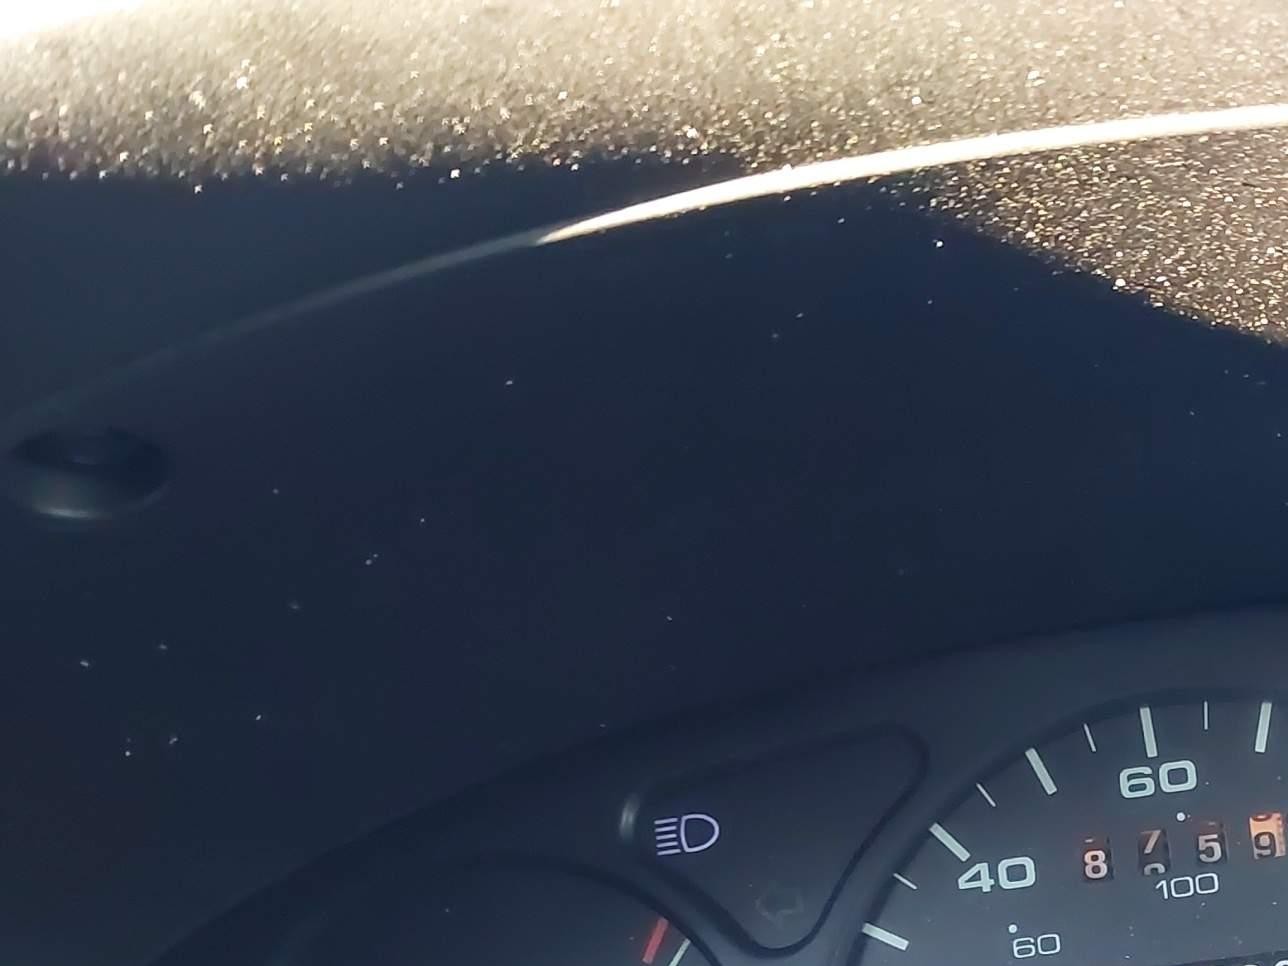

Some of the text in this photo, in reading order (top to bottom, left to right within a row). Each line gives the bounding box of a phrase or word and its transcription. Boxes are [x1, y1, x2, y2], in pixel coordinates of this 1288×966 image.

[1119, 760, 1198, 799] 60
[957, 856, 1036, 893] 40
[1155, 873, 1220, 900] 100
[1012, 933, 1061, 959] 60
